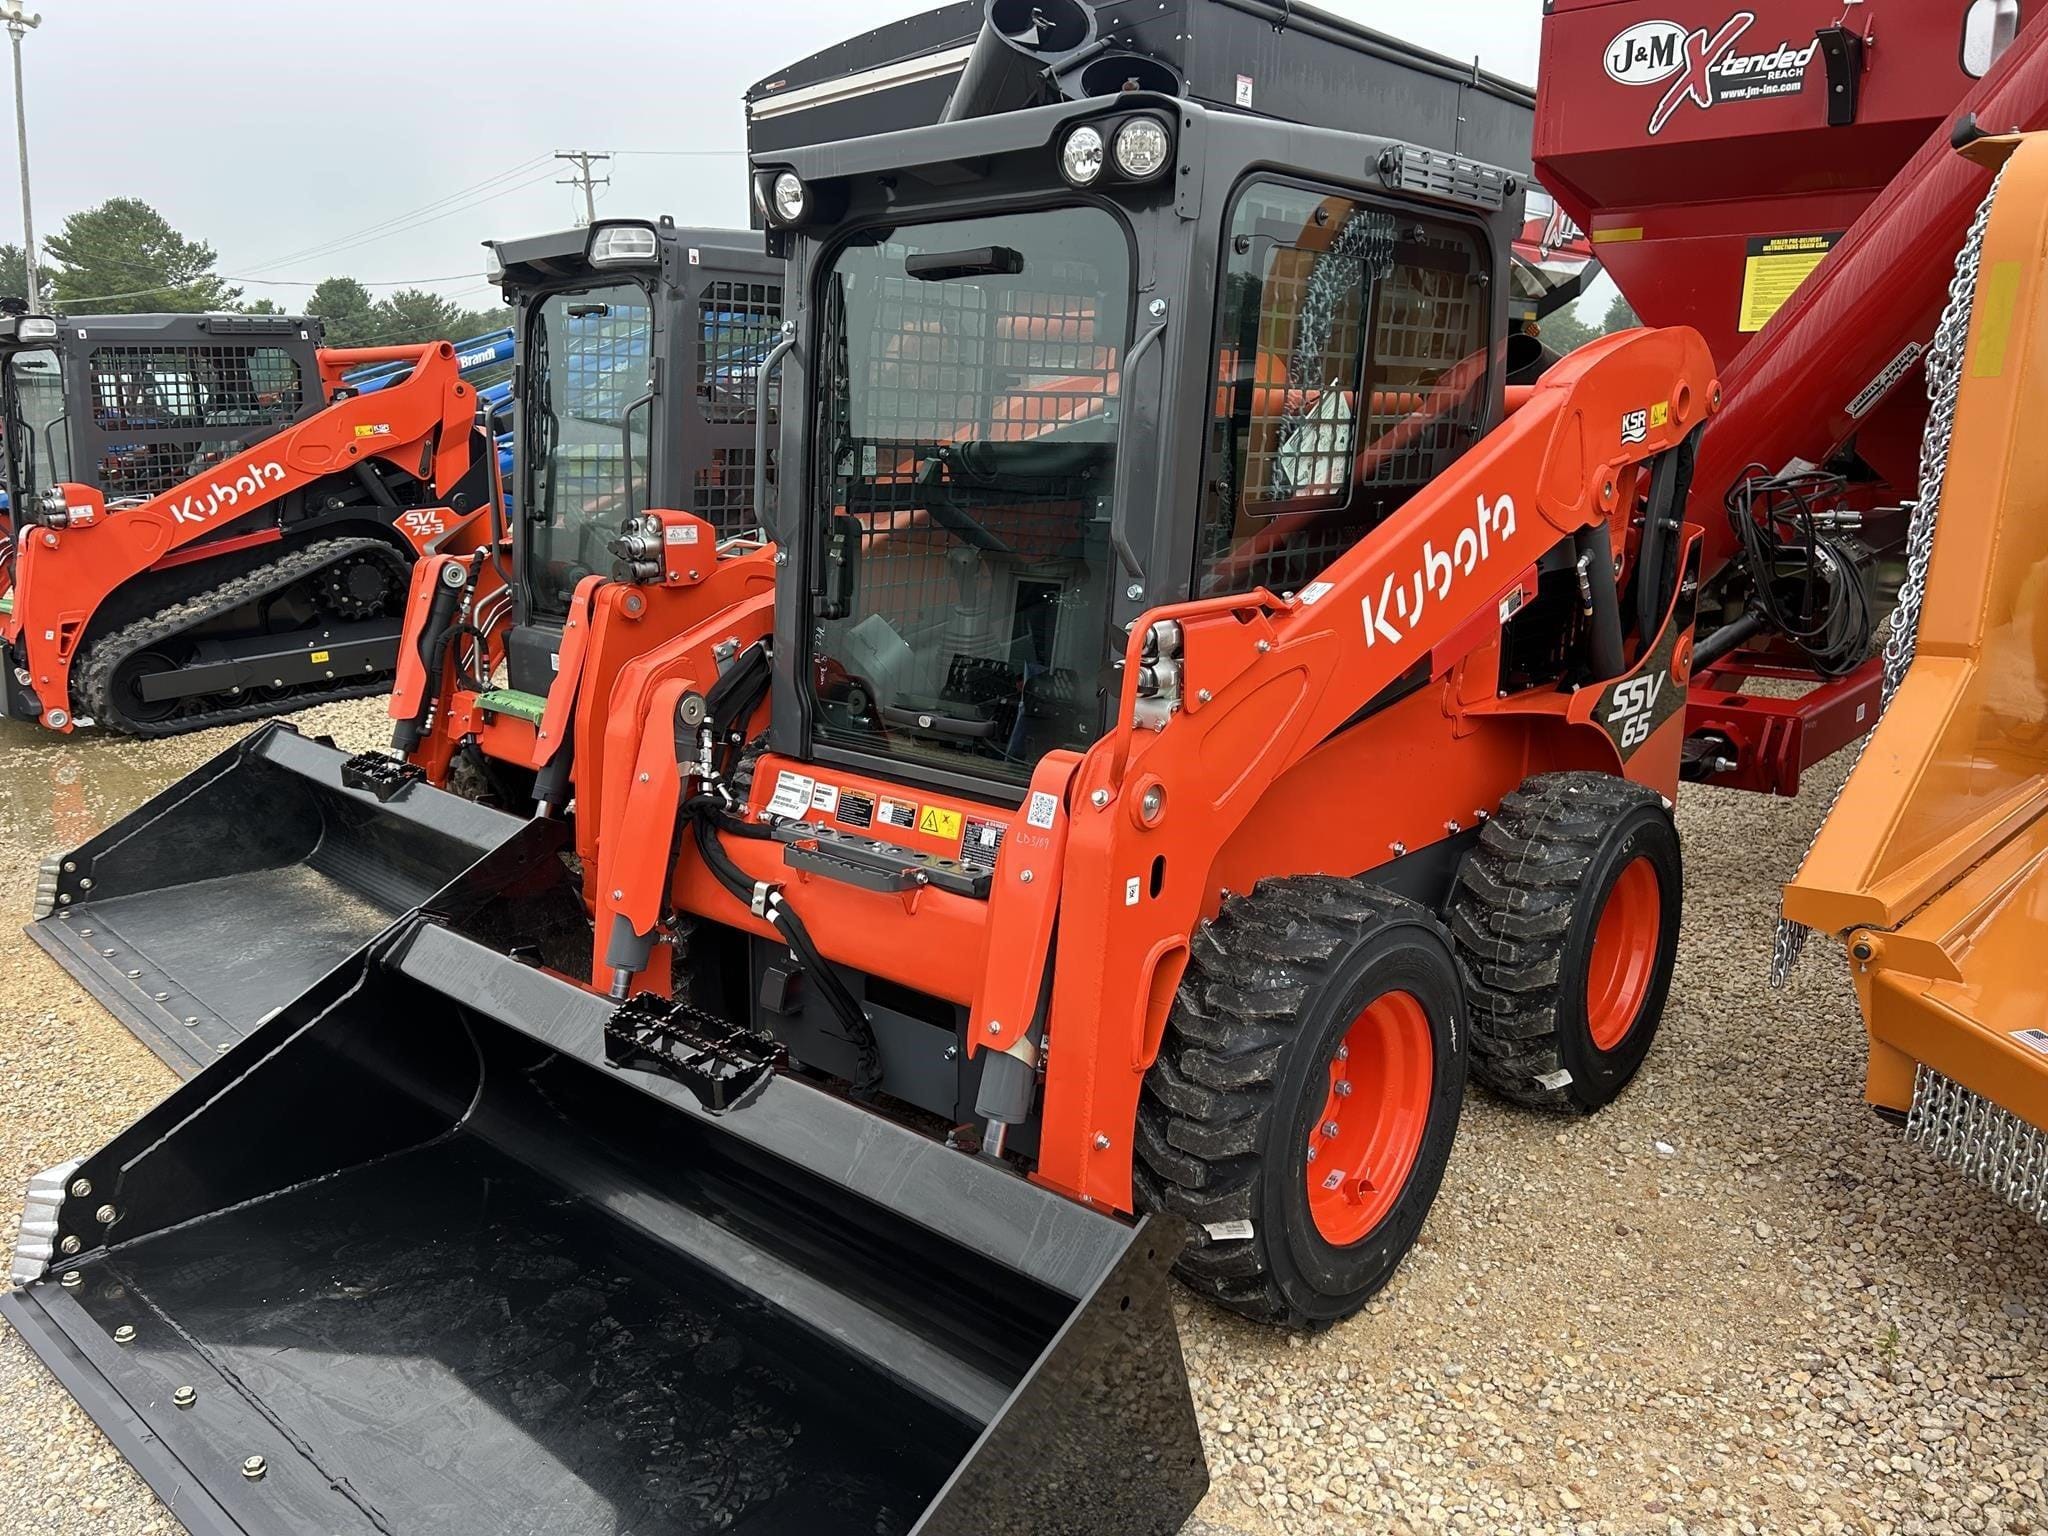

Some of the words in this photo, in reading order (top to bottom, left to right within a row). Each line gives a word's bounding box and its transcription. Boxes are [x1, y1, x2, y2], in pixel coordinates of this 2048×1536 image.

[1613, 33, 1677, 74] J&M
[1767, 67, 1804, 80] REACH
[1720, 81, 1801, 99] www.jm-inc.com
[460, 347, 496, 369] Brandt
[1622, 410, 1647, 432] KSR
[169, 462, 286, 524] Kubota
[405, 511, 443, 526] SVL
[412, 523, 445, 536] 75-3
[1361, 493, 1516, 648] Kubota
[1608, 669, 1667, 722] SSV
[1621, 711, 1653, 748] 65
